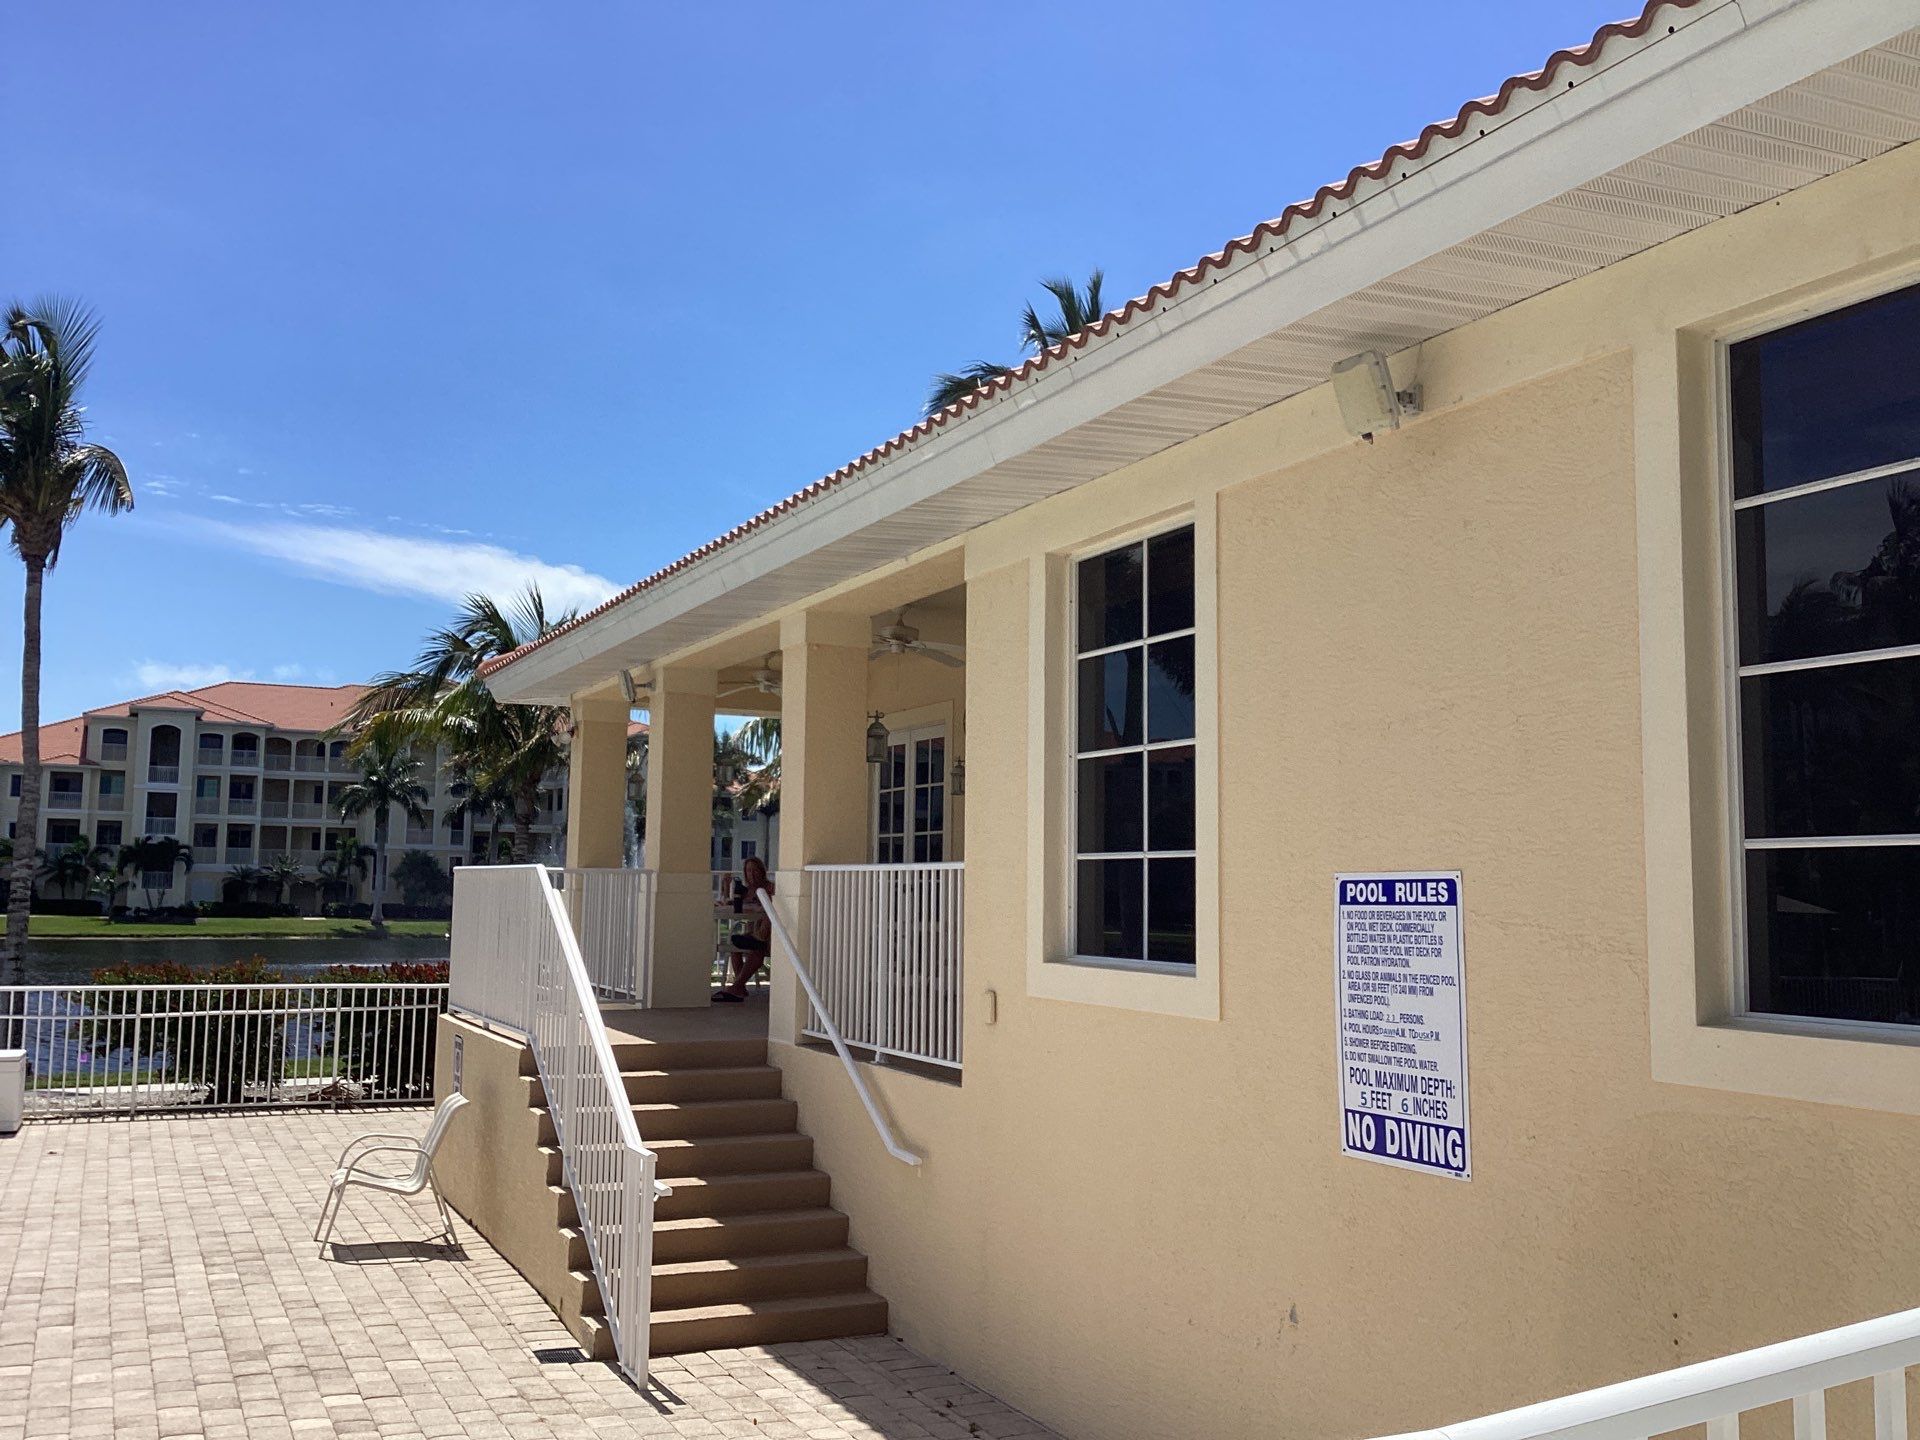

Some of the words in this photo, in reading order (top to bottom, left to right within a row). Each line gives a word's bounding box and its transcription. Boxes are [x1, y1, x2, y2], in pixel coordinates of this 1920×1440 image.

[1346, 883, 1387, 902] POOL
[1395, 882, 1448, 902] RULES
[1347, 910, 1353, 920] NO
[1354, 910, 1367, 920] FOOD
[1368, 911, 1375, 920] OR
[1376, 911, 1405, 921] BEVERAGES
[1406, 911, 1411, 921] IN
[1412, 911, 1422, 921] THE
[1423, 911, 1437, 921] POOL
[1438, 911, 1447, 922] OR
[1347, 922, 1353, 931] ON
[1354, 922, 1367, 931] POOL
[1368, 922, 1378, 931] WET
[1395, 923, 1435, 933] COMMERCIALLY
[1347, 933, 1367, 943] BOTTLED
[1369, 934, 1385, 943] WATER
[1386, 934, 1392, 943] IN
[1393, 934, 1413, 944] PLASTIC
[1414, 935, 1437, 945] BOTTLES
[1438, 936, 1443, 945] IS
[1347, 945, 1370, 954] ALLOWED
[1371, 945, 1378, 954] ON
[1379, 946, 1388, 955] THE
[1390, 946, 1403, 956] POOL
[1404, 946, 1414, 956] WET
[1415, 947, 1430, 957] DECK
[1431, 947, 1442, 958] FOR
[1347, 956, 1360, 965] POOL
[1361, 956, 1380, 966] PATRON
[1381, 957, 1411, 968] HYDRATION.
[1347, 970, 1354, 979] NO
[1355, 970, 1371, 980] GLASS
[1372, 971, 1379, 981] OR
[1380, 972, 1401, 982] ANIMALS
[1402, 973, 1408, 983] IN
[1408, 973, 1418, 984] THE
[1420, 974, 1440, 985] FENCED
[1441, 975, 1456, 986] POOL
[1348, 981, 1361, 991] AREA
[1378, 983, 1389, 994] FEET
[1419, 985, 1434, 996] FROM
[1348, 993, 1373, 1004] UNFENCED
[1348, 1009, 1369, 1020] BATHING
[1349, 1022, 1361, 1033] POOL
[1408, 1028, 1415, 1038] TO
[1349, 1037, 1369, 1048] SHOWER
[1370, 1039, 1390, 1051] BEFORE
[1391, 1041, 1417, 1054] ENTERING.
[1350, 1051, 1356, 1061] DO
[1357, 1052, 1366, 1062] NOT
[1367, 1053, 1392, 1065] SWALLOW
[1393, 1056, 1403, 1067] THE
[1404, 1057, 1418, 1069] POOL
[1350, 1067, 1373, 1087] POOL
[1375, 1070, 1418, 1093] MAXIMUM
[1421, 1076, 1456, 1099] DEPTH:
[1360, 1091, 1367, 1106] 5
[1371, 1091, 1392, 1111] FEET
[1401, 1098, 1409, 1112] 6
[1413, 1097, 1448, 1120] INCHES
[1347, 1112, 1376, 1150] NO
[1385, 1118, 1463, 1168] DIVING
